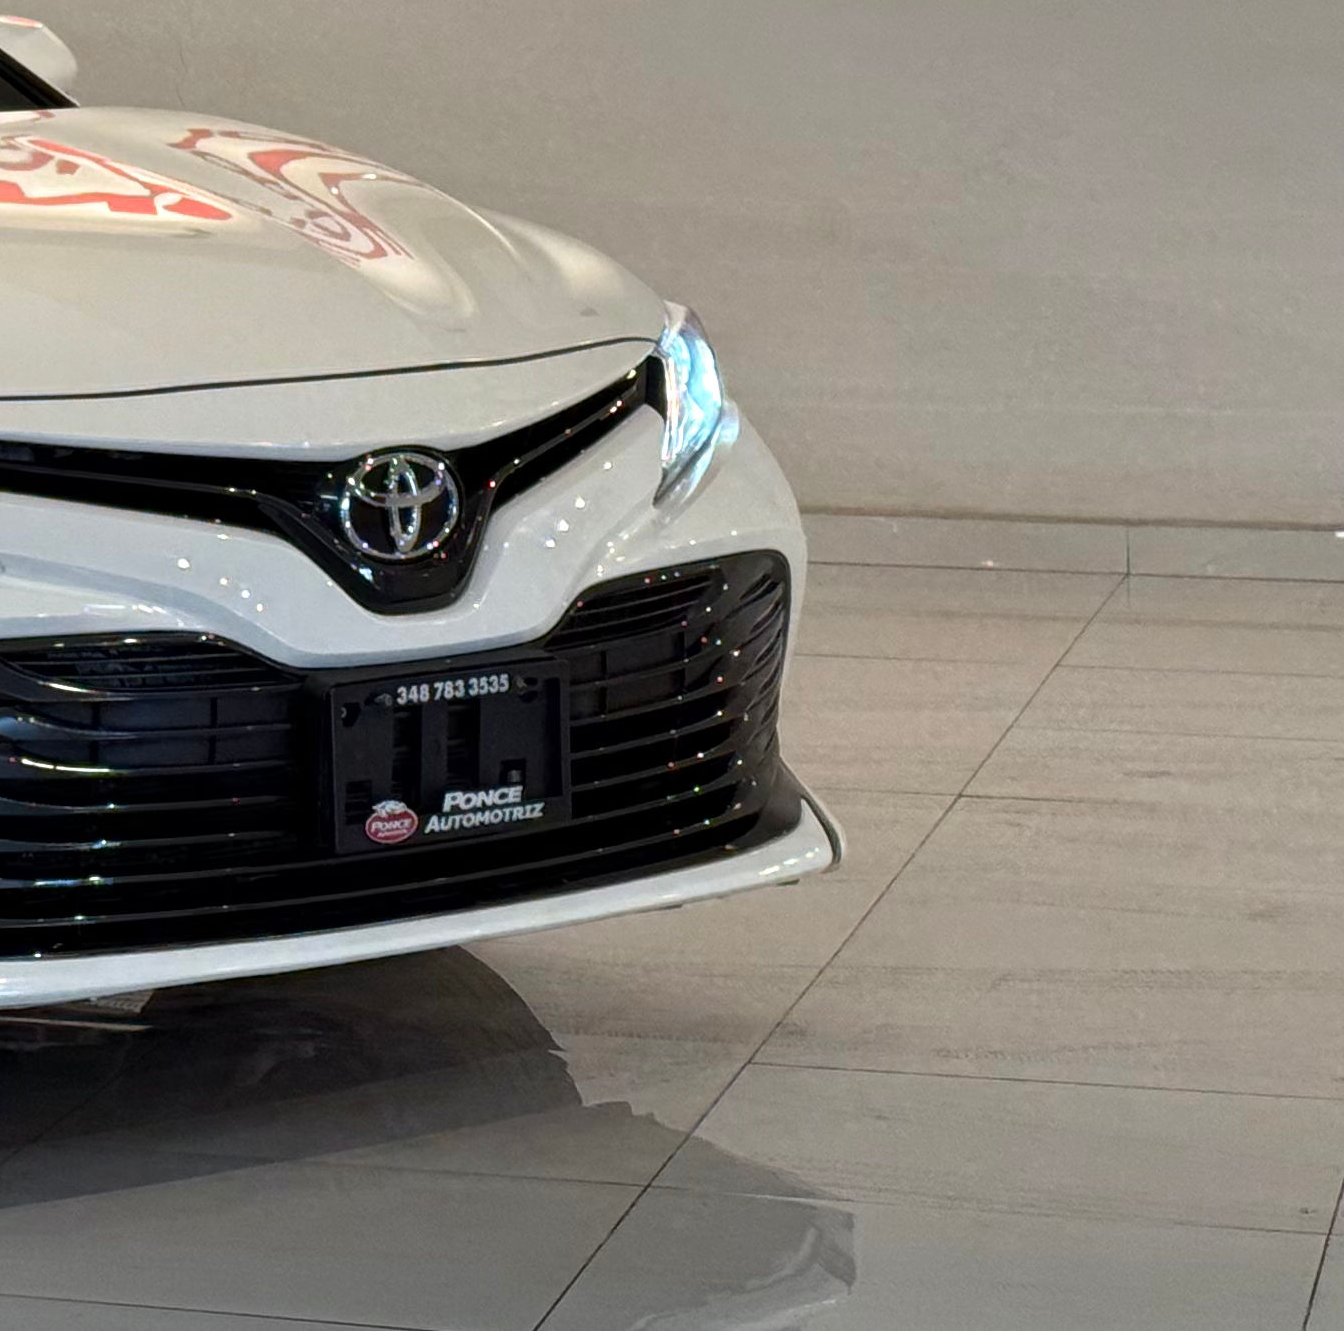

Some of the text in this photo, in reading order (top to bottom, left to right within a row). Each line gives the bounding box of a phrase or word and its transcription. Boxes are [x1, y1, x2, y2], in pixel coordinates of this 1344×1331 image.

[397, 673, 510, 705] 348 783 3535
[442, 785, 524, 812] PONCE
[424, 802, 545, 834] AUTOMOTRIZ
